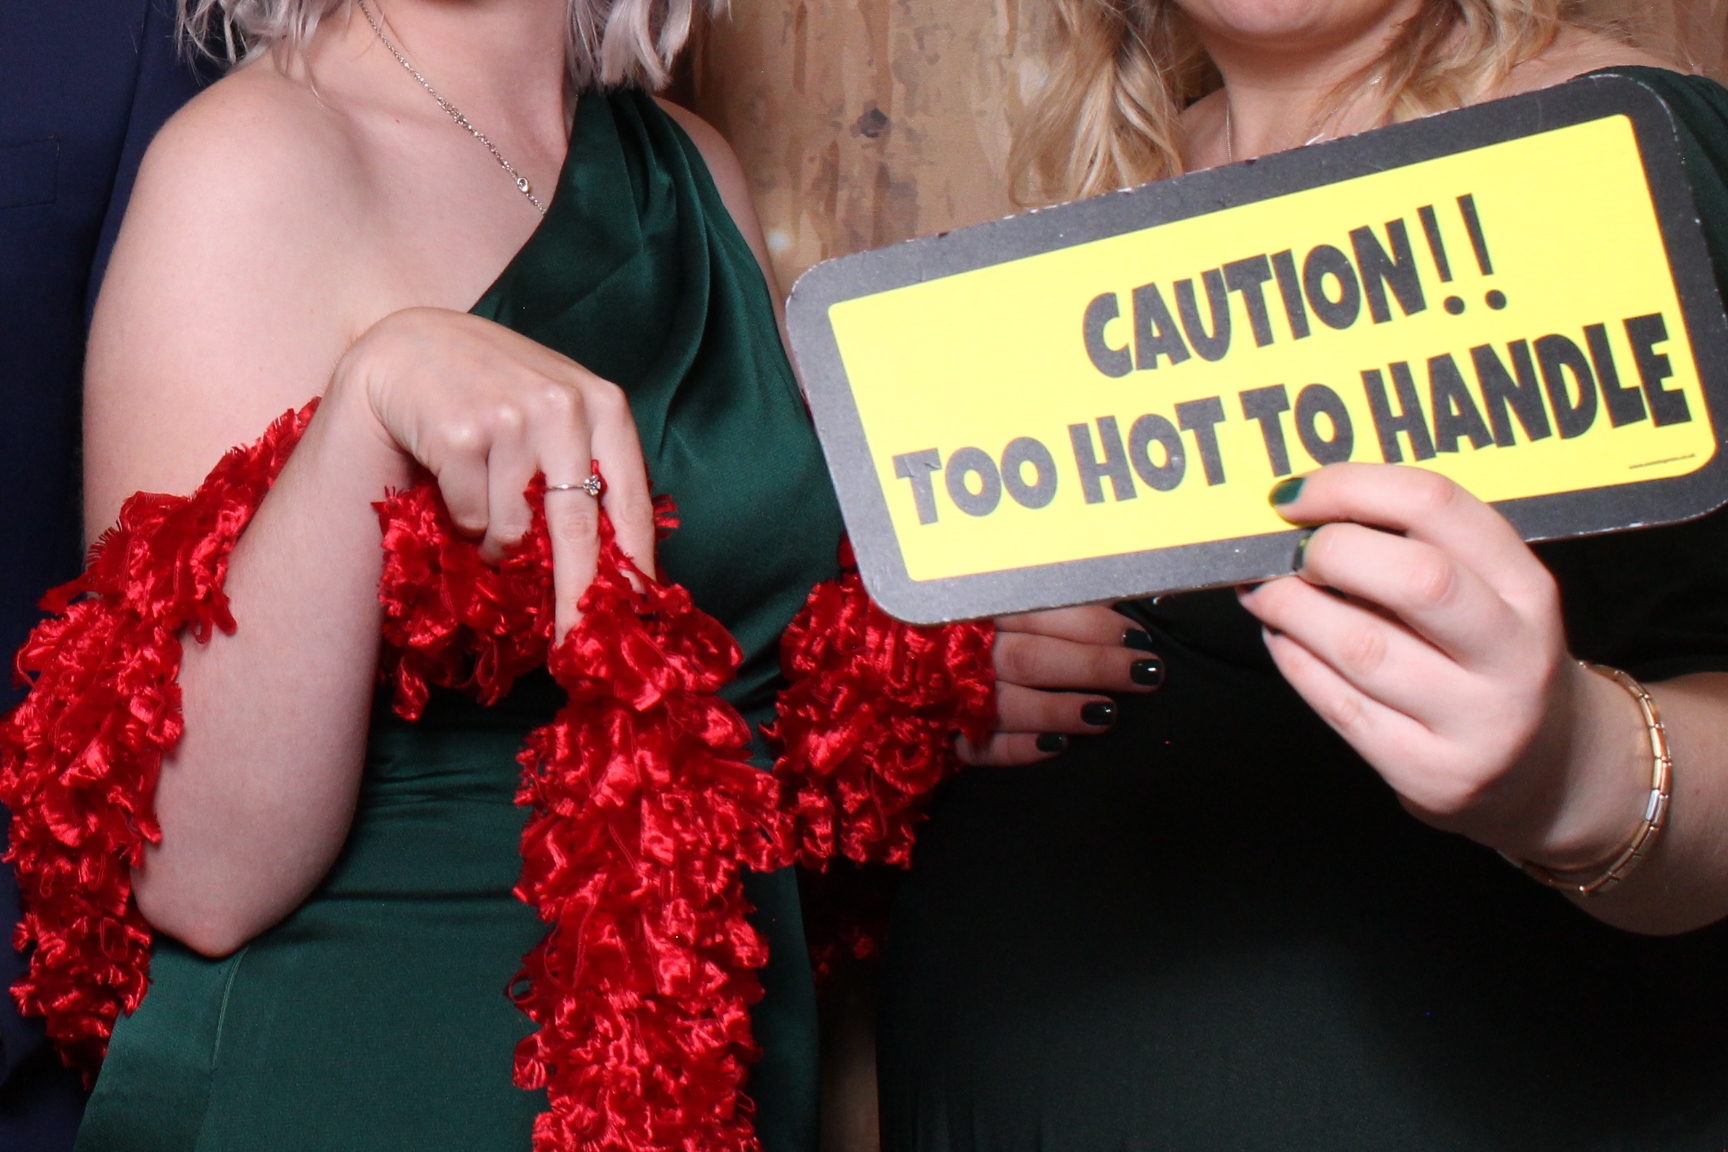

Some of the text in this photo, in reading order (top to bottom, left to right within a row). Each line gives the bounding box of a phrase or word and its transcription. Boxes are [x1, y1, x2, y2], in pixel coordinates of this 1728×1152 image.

[1082, 193, 1508, 378] CAUTION!!
[892, 312, 1692, 525] TOO HOT TO HANDLE
